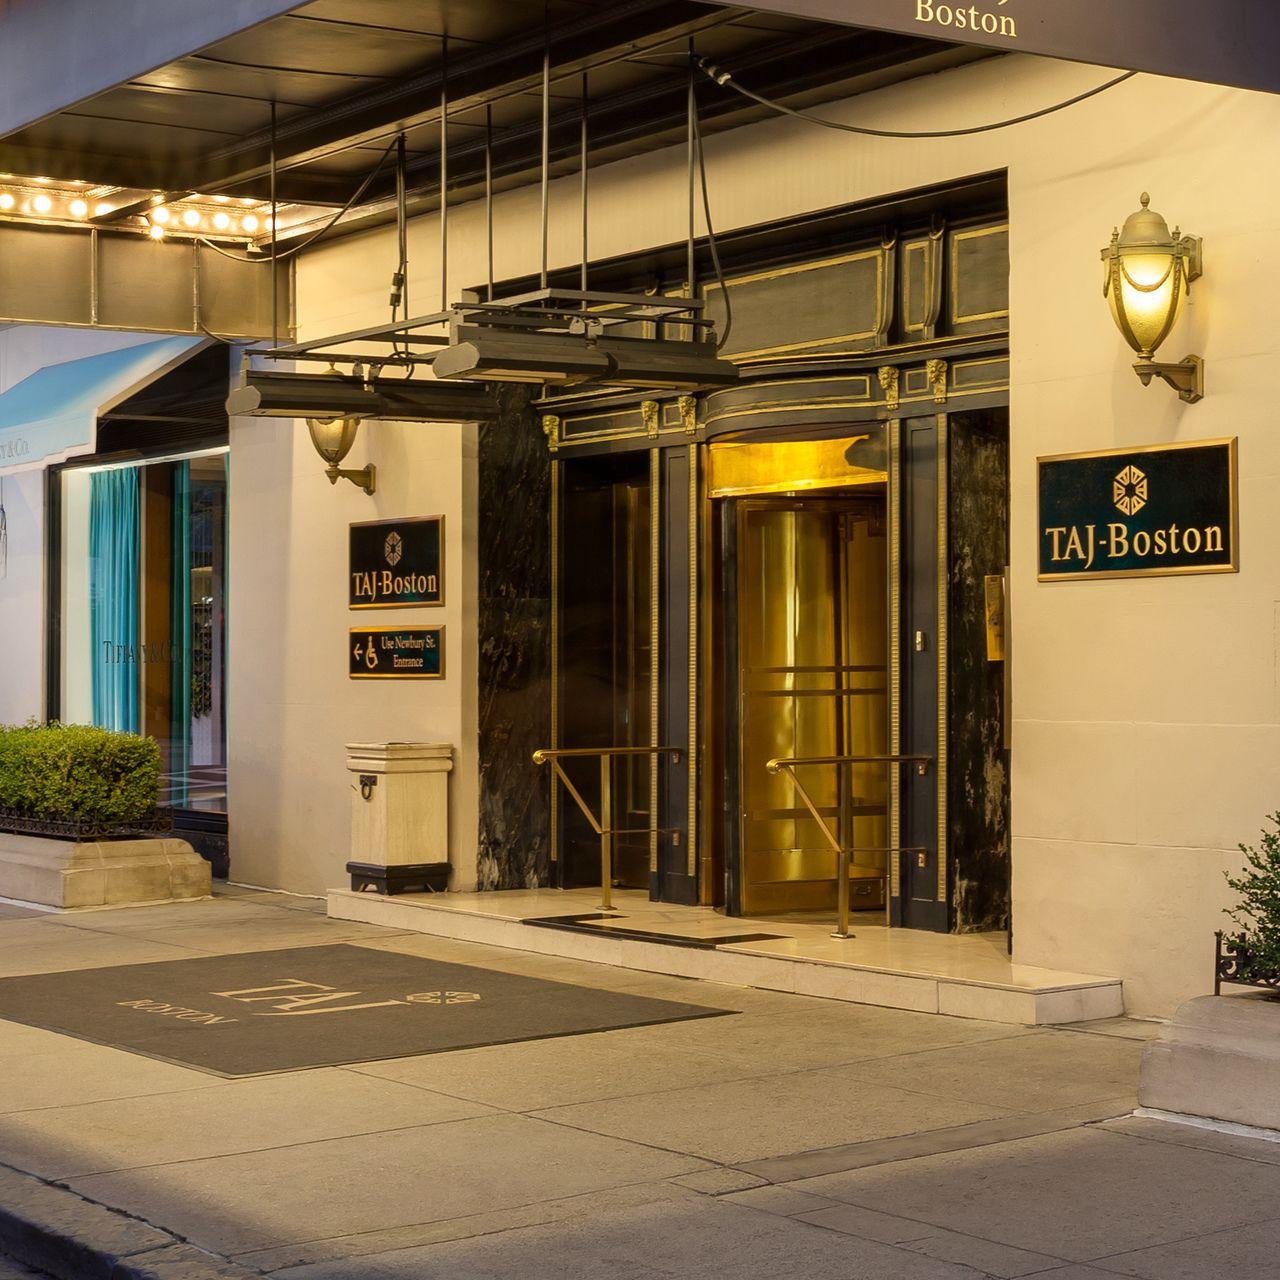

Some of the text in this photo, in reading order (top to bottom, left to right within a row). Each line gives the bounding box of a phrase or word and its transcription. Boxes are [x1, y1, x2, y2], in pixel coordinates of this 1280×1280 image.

[1045, 523, 1224, 569] TAJ-Boston
[352, 570, 438, 602] TAJ-Boston
[381, 634, 436, 651] Use Newbury St.
[393, 654, 424, 668] Entrance
[116, 999, 239, 1025] BOSTON
[208, 978, 412, 1017] TAJ
